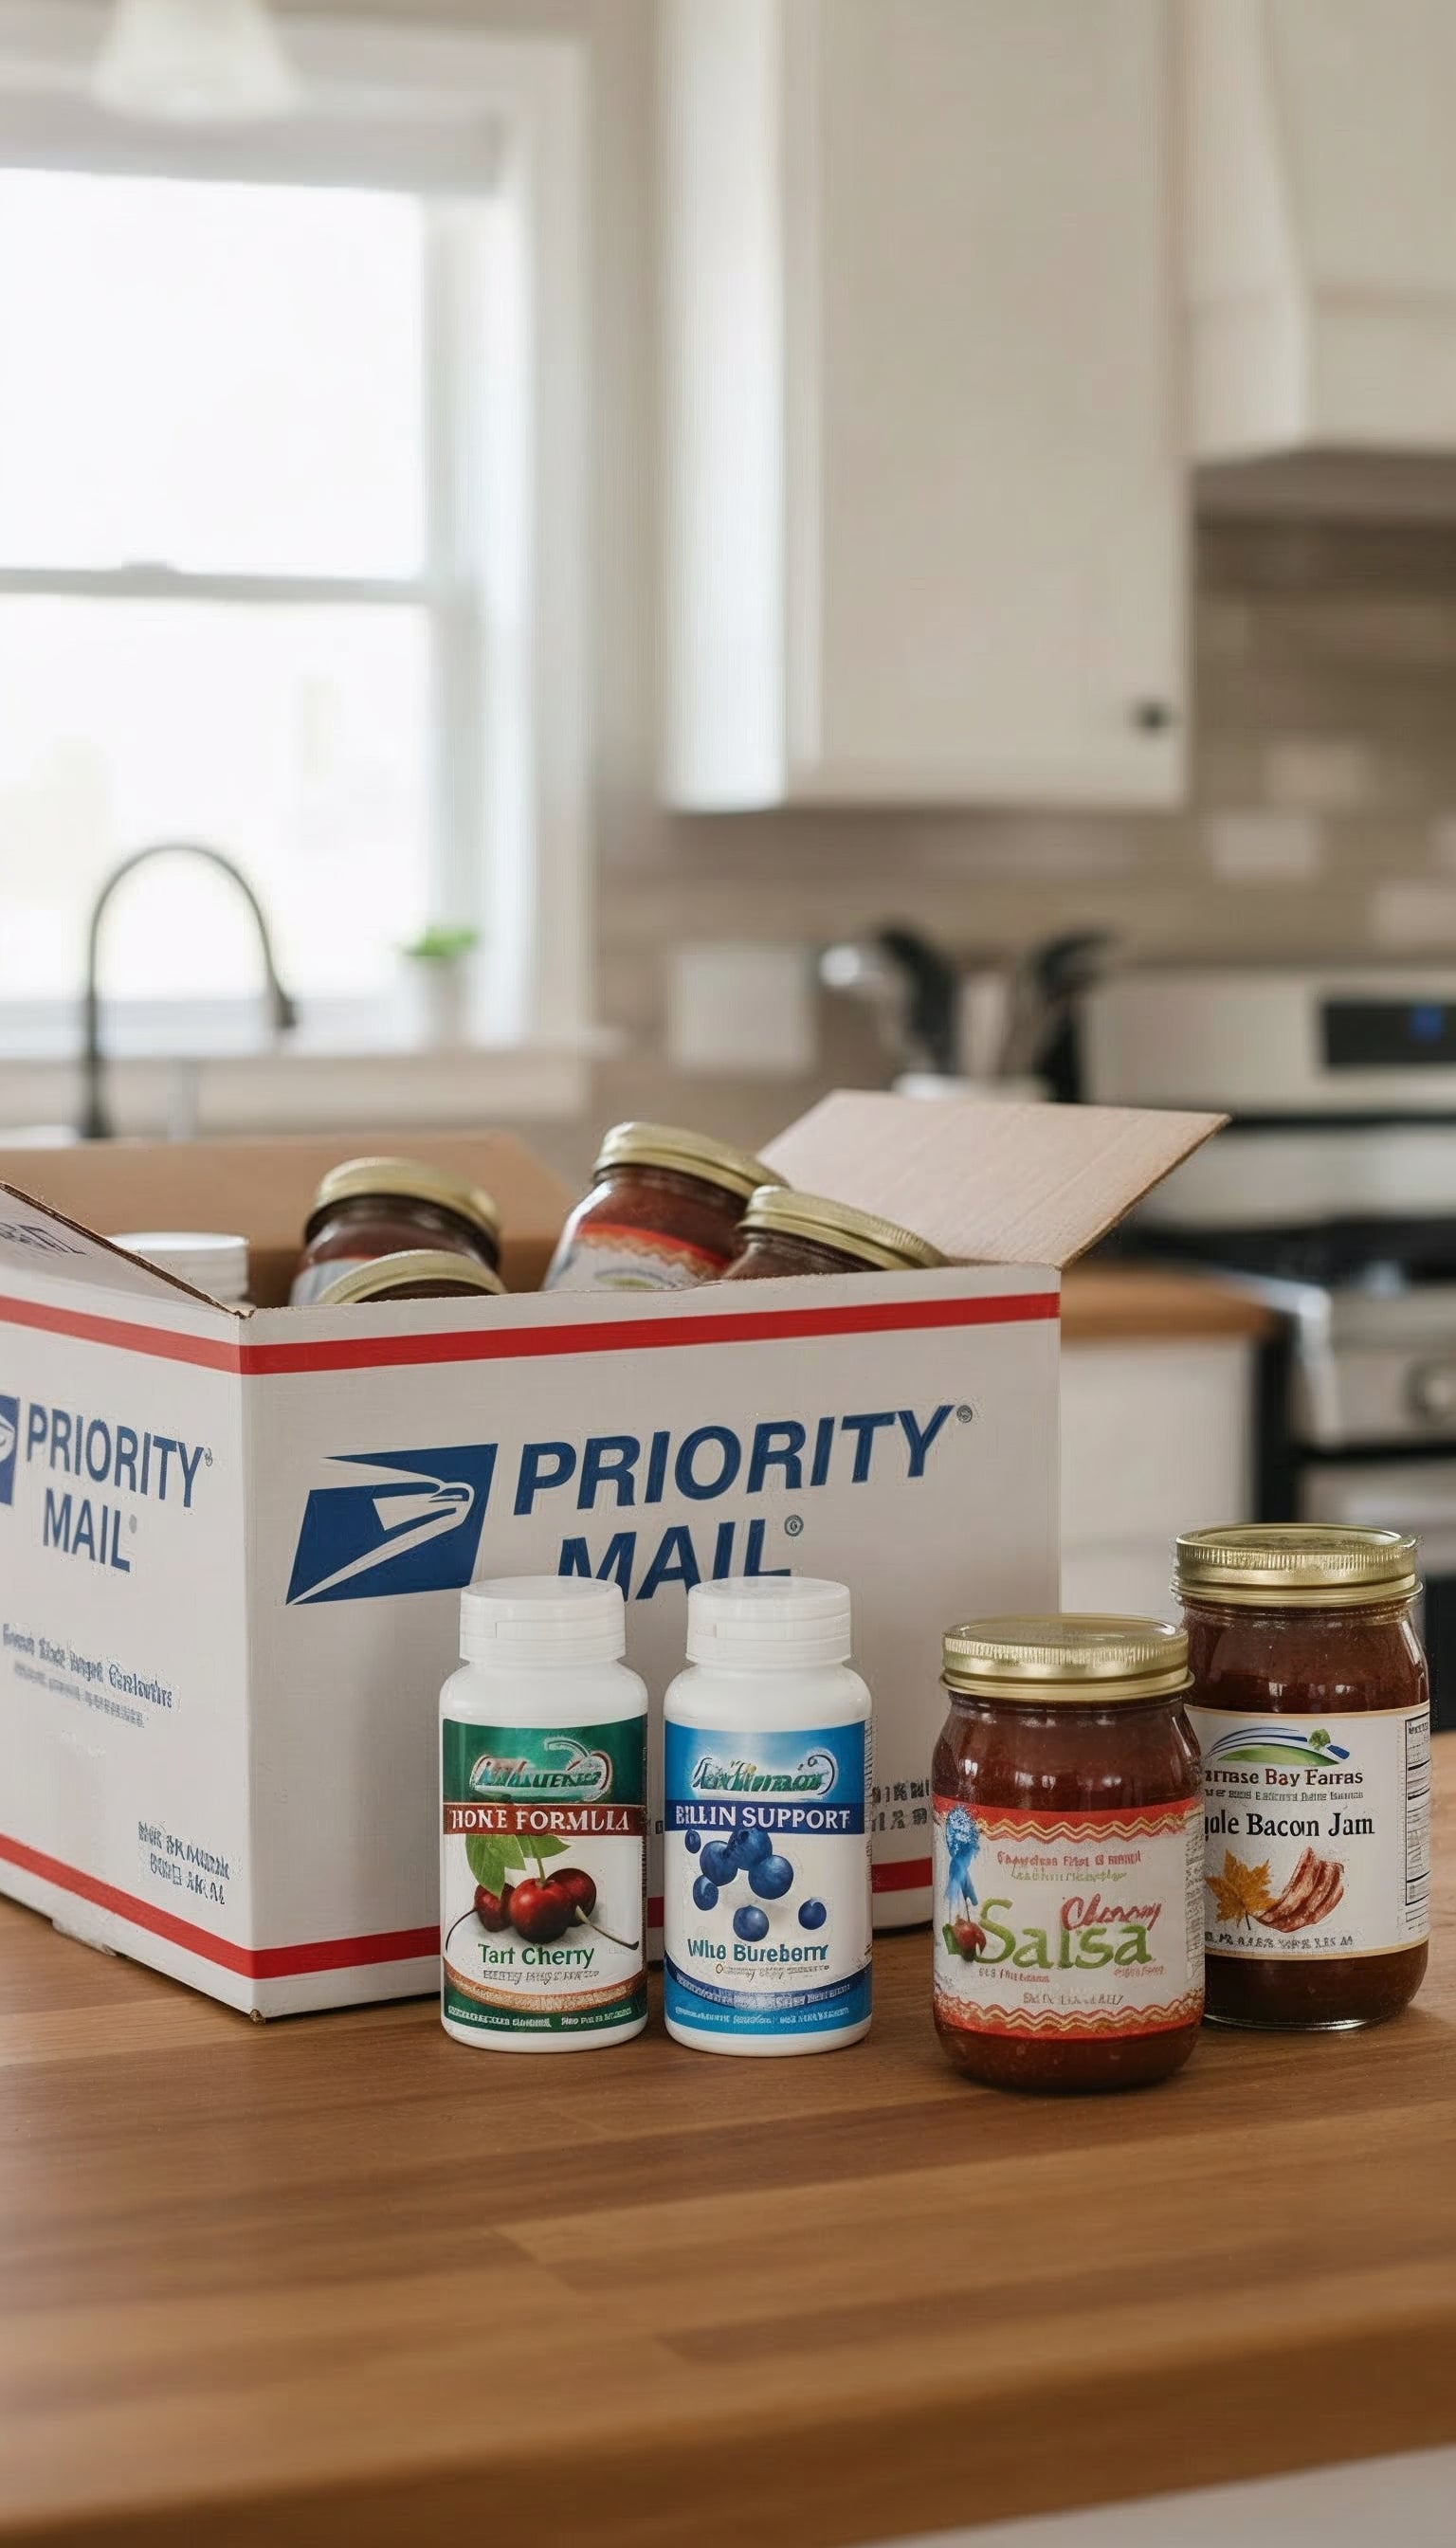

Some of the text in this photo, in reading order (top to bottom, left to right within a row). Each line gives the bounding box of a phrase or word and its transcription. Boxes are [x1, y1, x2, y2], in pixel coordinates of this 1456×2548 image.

[26, 1402, 205, 1508] PRIORITY
[514, 1404, 956, 1516] PRIORITY
[43, 1487, 131, 1573] MAIL
[557, 1519, 792, 1602] MAIL
[1265, 1768, 1301, 1787] Bay
[742, 1807, 851, 1829] SUPPORT
[1328, 1812, 1375, 1837] Jam
[478, 1943, 594, 1970] Tart Cherry
[974, 1898, 1153, 1969] Salsa
